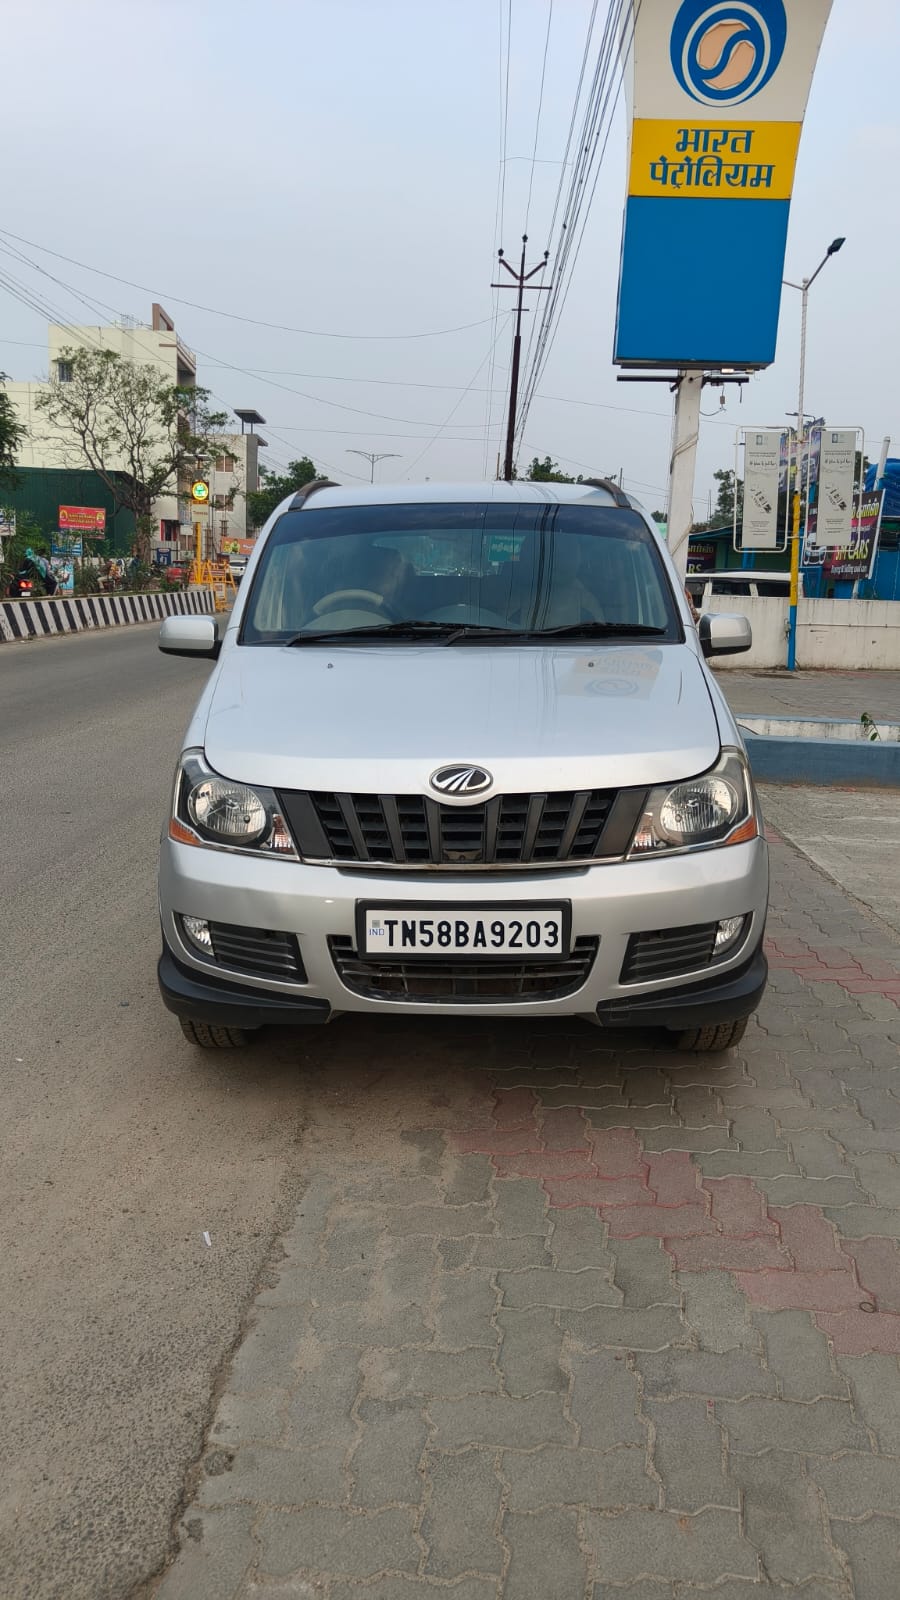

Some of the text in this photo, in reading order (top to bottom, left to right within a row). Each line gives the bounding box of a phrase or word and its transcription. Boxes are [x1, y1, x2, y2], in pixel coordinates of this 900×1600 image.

[675, 129, 755, 153] भारत
[649, 155, 776, 189] पेट्रोलियम
[848, 539, 870, 560] CARS
[688, 563, 702, 574] RS
[384, 920, 559, 947] TN58BA9203
